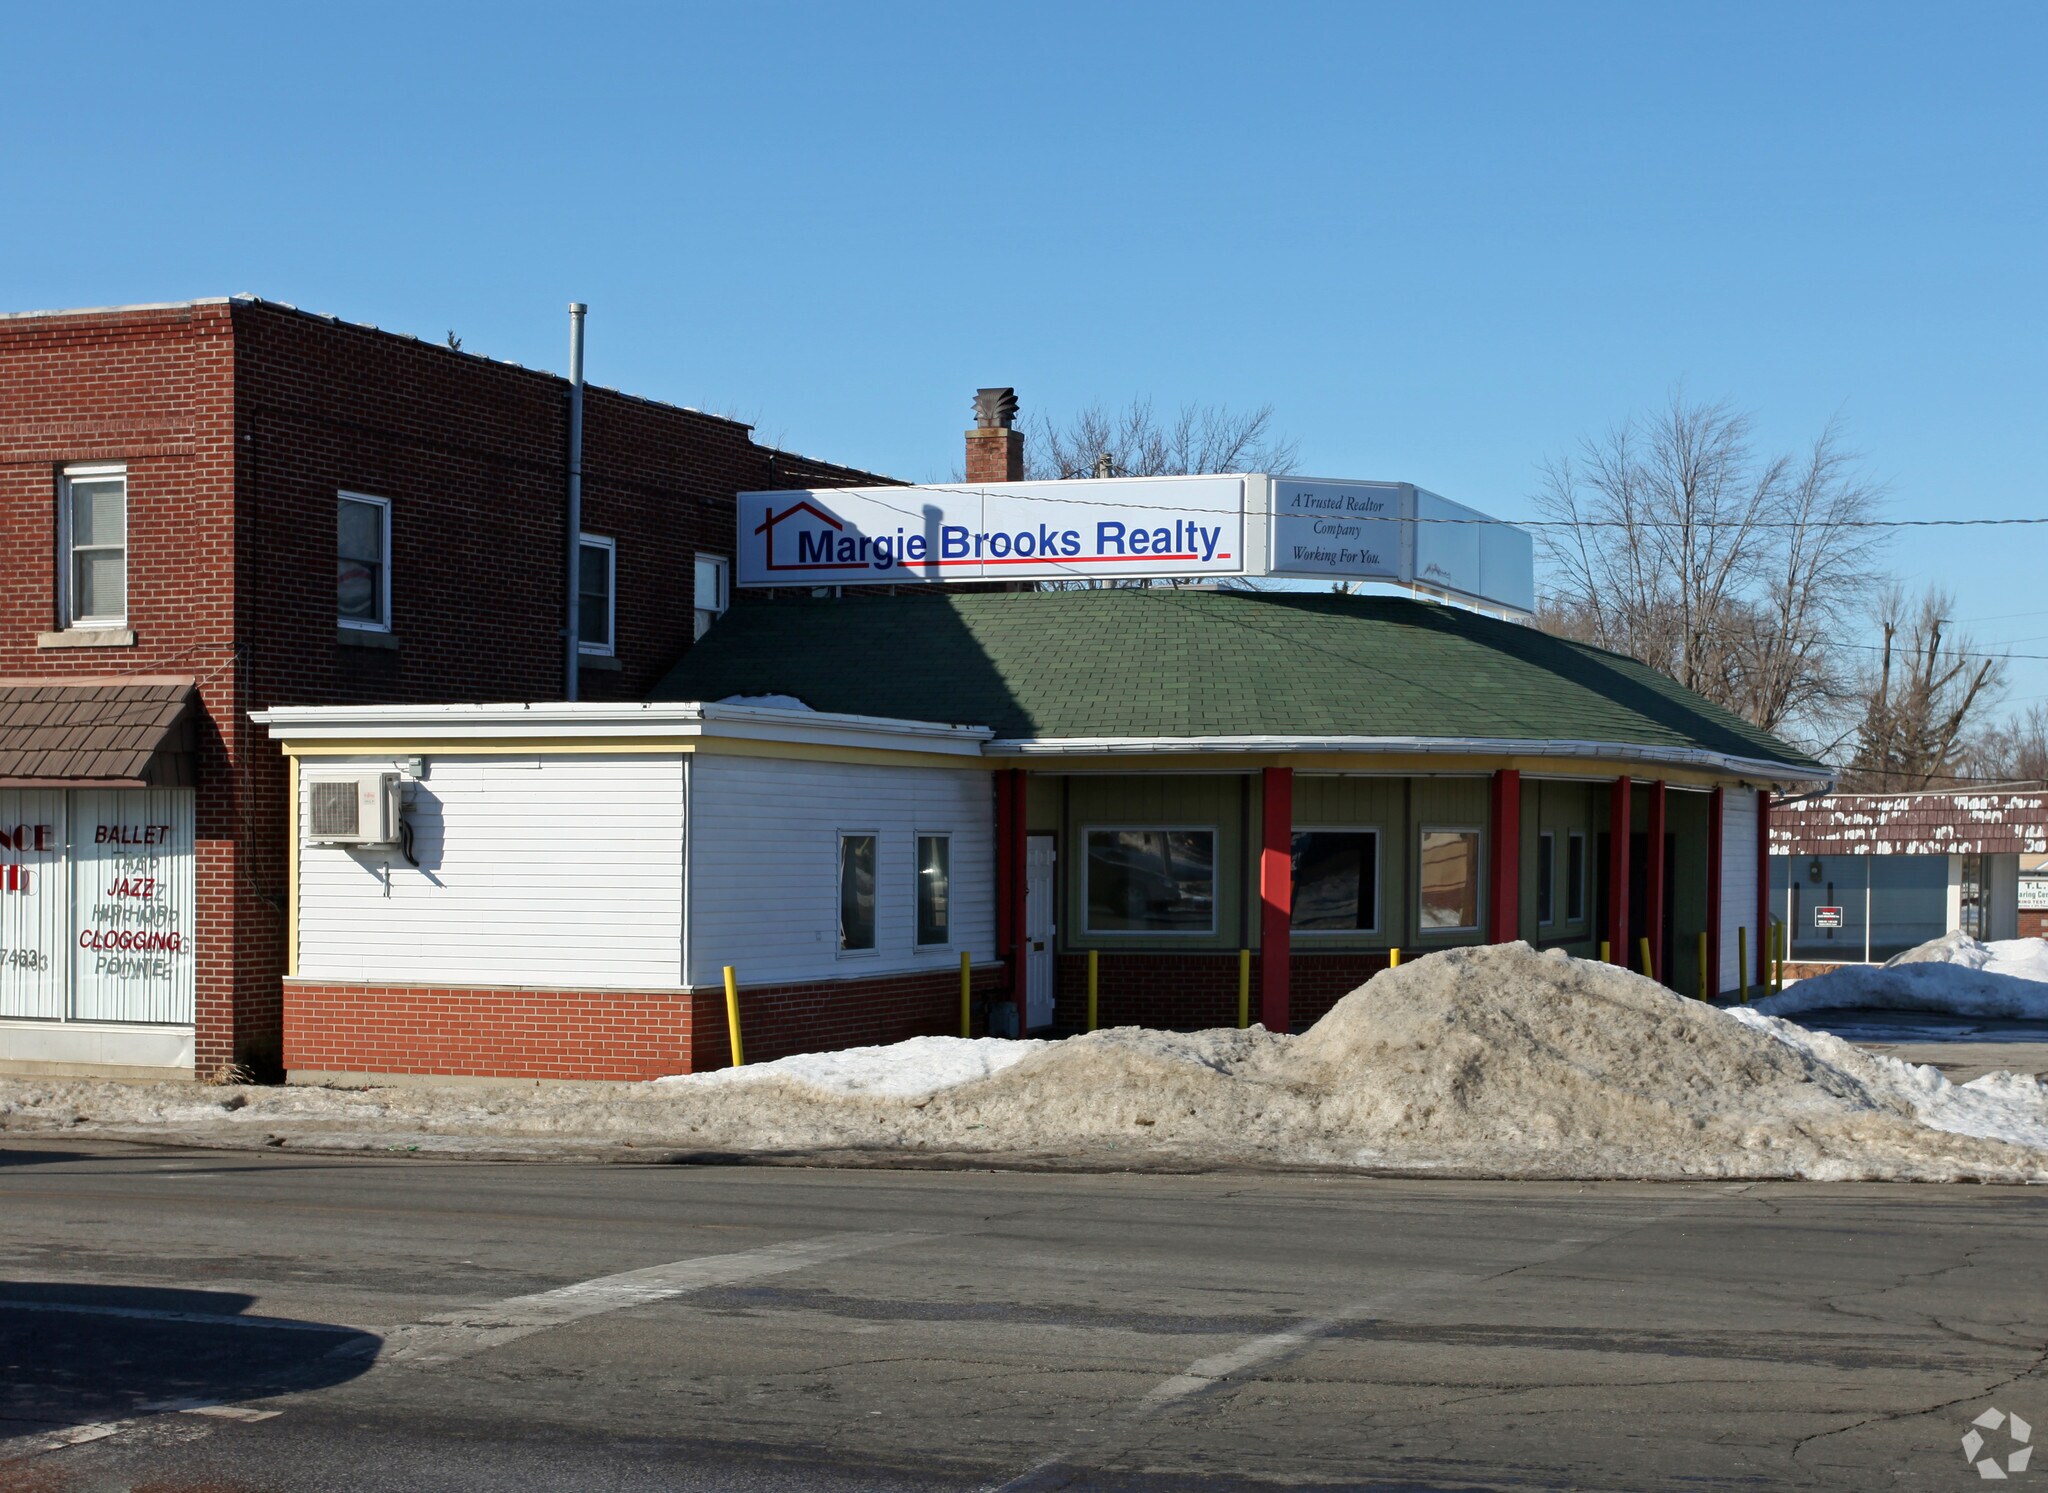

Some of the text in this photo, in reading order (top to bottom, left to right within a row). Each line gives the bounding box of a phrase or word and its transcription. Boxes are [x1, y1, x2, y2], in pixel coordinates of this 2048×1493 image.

[1290, 492, 1384, 512] A Trusted Realtor
[1313, 520, 1361, 540] Company
[798, 519, 1222, 570] Margie Brooks Realty
[1293, 546, 1380, 566] Working For You.
[94, 825, 169, 844] BALLET
[107, 877, 156, 897] JAZZ
[79, 929, 181, 951] CLOGGING
[94, 956, 166, 977] POINTE
